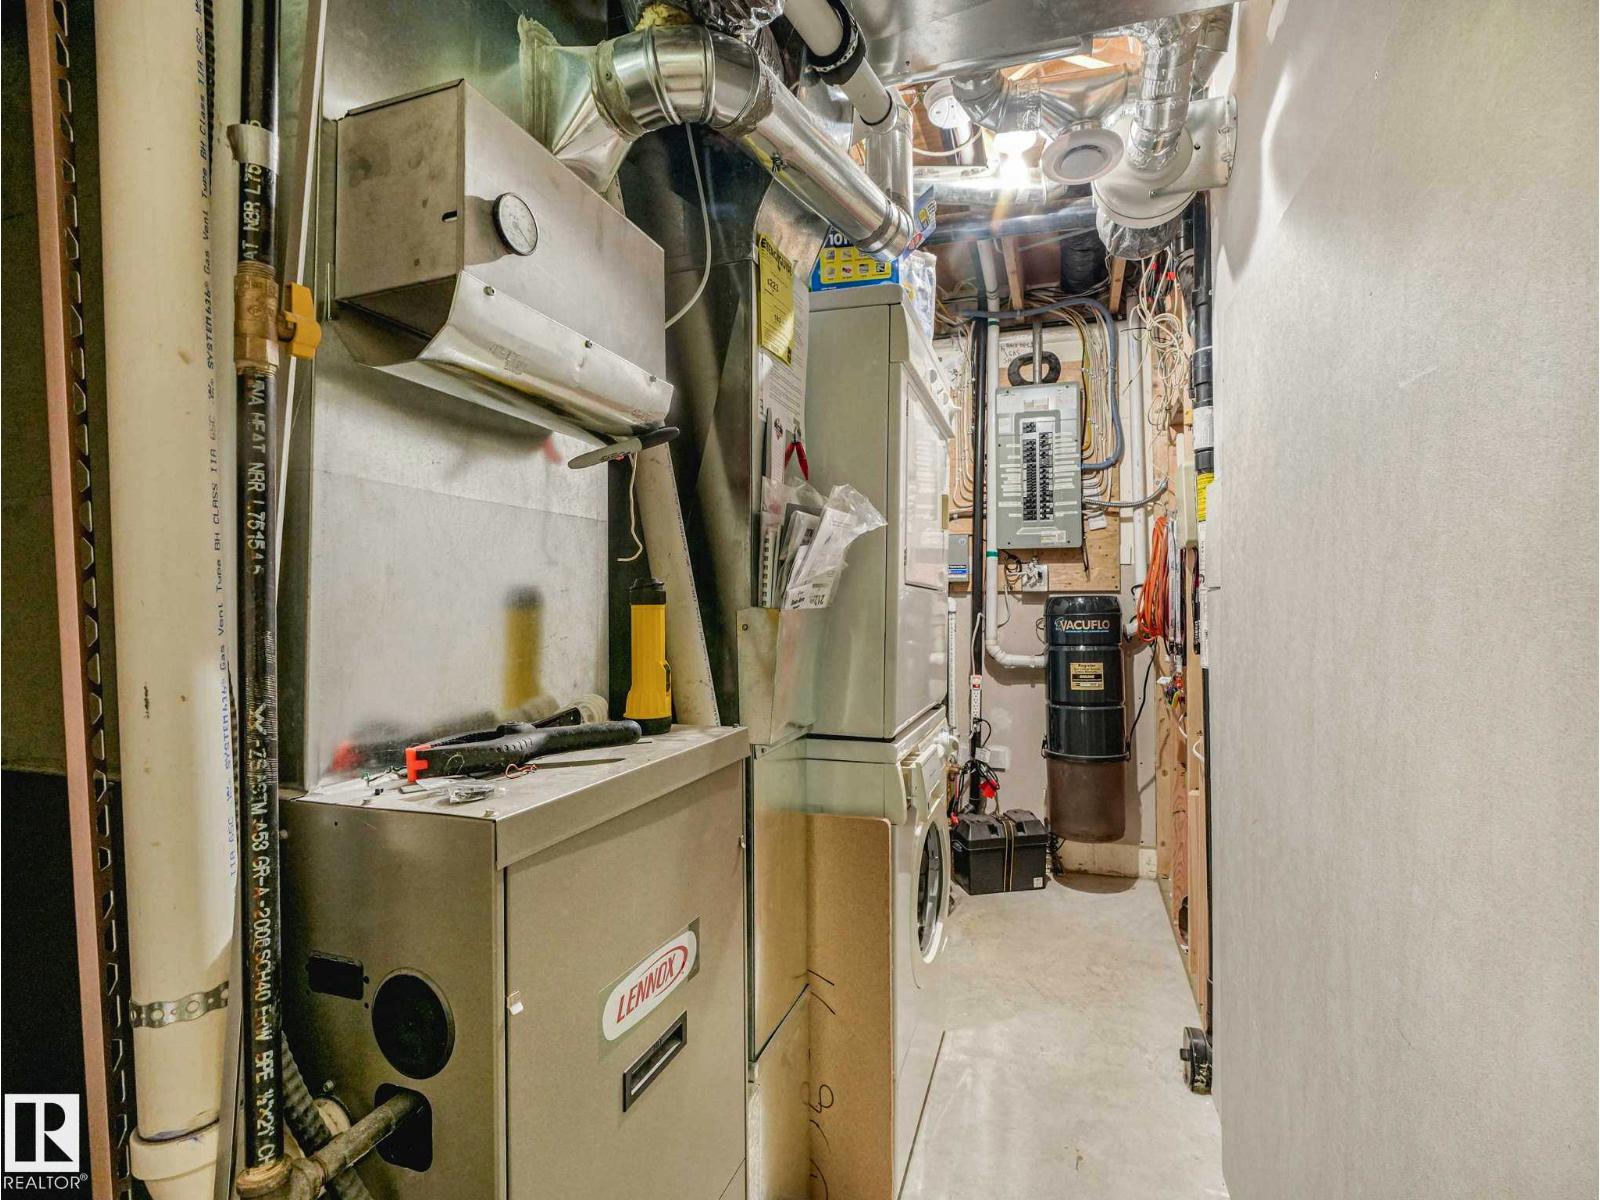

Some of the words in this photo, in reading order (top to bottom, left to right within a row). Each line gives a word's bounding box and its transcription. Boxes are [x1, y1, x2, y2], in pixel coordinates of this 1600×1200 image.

[201, 167, 209, 199] Type
[202, 210, 210, 240] Vent
[203, 250, 211, 275] Gas
[248, 462, 266, 492] NBR
[211, 483, 220, 525] CLASS
[214, 533, 221, 551] BH
[215, 559, 223, 592] Type
[217, 602, 225, 636] Vent
[1060, 619, 1110, 632] VACUFLO
[219, 645, 227, 670] Gas
[253, 949, 272, 1001] SCH40
[616, 953, 676, 1024] LENNOX
